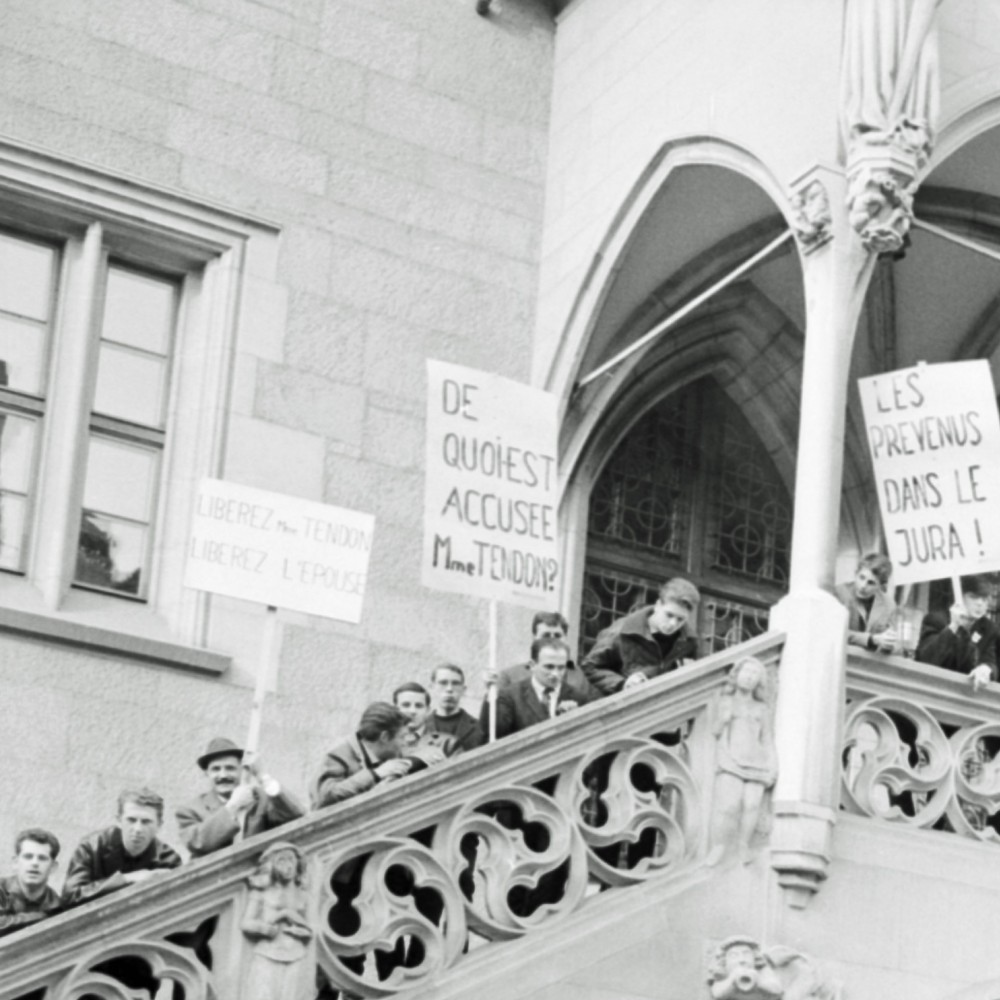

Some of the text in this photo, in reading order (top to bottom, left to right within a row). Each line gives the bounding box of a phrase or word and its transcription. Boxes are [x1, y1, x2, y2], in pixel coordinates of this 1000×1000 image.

[442, 379, 478, 421] DE
[873, 372, 925, 413] LES
[869, 411, 983, 459] PREVENUS
[441, 486, 555, 542] ACCUSEE
[884, 464, 986, 514] DANS LE
[196, 494, 274, 531] LIBEREZ
[303, 516, 372, 552] TENDON
[893, 522, 965, 567] JURA
[190, 537, 367, 595] LIBEREZ L'EPOUSE
[473, 540, 558, 592] TENDON?
